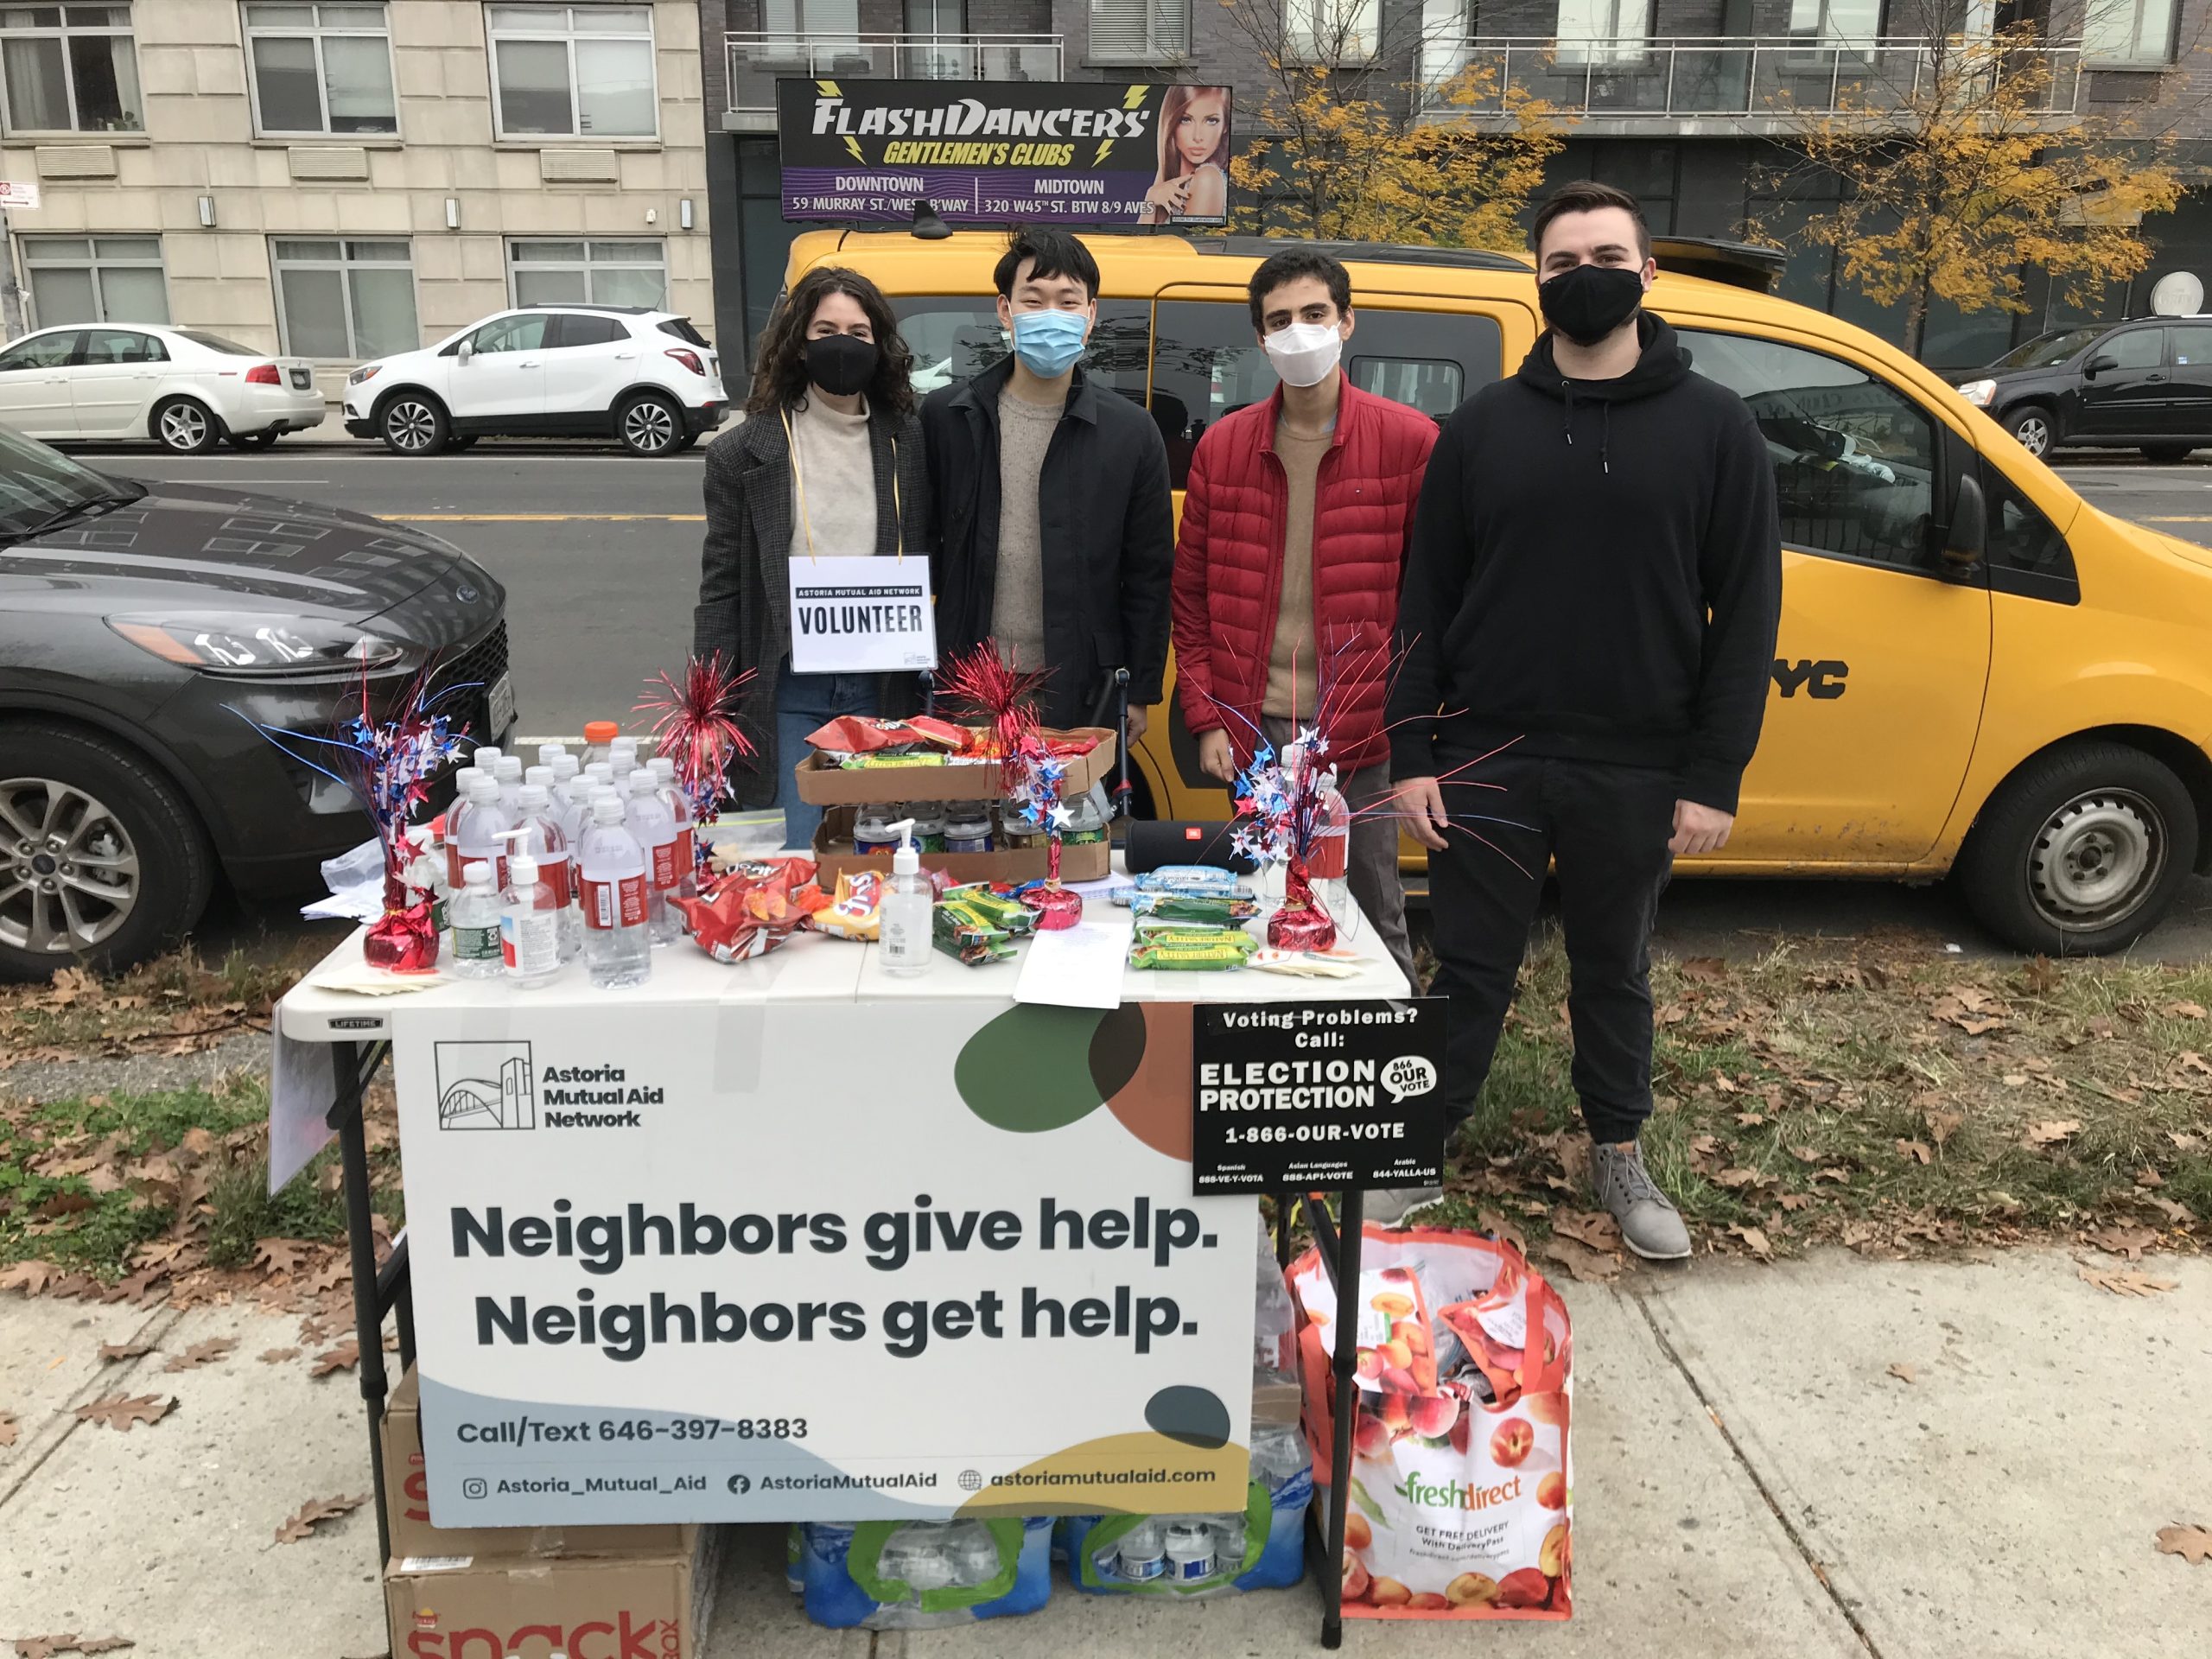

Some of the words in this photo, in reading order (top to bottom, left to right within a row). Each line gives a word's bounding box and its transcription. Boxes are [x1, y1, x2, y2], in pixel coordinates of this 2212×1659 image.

[883, 141, 1007, 165] GENTLEMEN'S
[1009, 143, 1076, 166] CLUBS
[836, 176, 925, 192] DOWNTOWN
[1034, 179, 1104, 194] MIDTOWN
[791, 197, 809, 210] 59
[812, 198, 866, 210] MURRAY
[869, 199, 918, 211] ST./WES
[931, 199, 969, 212] B'WAY
[984, 200, 1009, 213] 320
[1051, 201, 1068, 213] ST.
[1071, 201, 1100, 213] BTW
[1102, 201, 1122, 214] 8/9
[1124, 201, 1154, 214] AVES
[798, 588, 833, 597] ASTORIA
[798, 605, 923, 635] VOLUNTEER
[1770, 658, 1849, 699] YC
[1223, 1011, 1294, 1029] Voting
[1302, 1007, 1418, 1026] Problems?
[1294, 1033, 1344, 1048] Call:
[543, 1064, 626, 1083] Astoria
[1200, 1059, 1376, 1086] ELECTION
[1393, 1059, 1413, 1071] 866
[1389, 1067, 1427, 1084] OUR
[1400, 1080, 1430, 1093] VOTE
[543, 1088, 624, 1106] Mutual
[626, 1086, 664, 1105] Aid
[1200, 1085, 1375, 1112] PROTECTION
[544, 1110, 642, 1128] Network
[1225, 1122, 1405, 1143] 1-866-OUR-VOTE
[1310, 1161, 1348, 1170] Languages
[1372, 1167, 1436, 1179] 844-YALLA-US
[1198, 1174, 1264, 1184] 888-VE-Y-VOTA
[1282, 1171, 1353, 1181] 888-API-VOTE
[450, 1198, 848, 1275] Neighbors
[863, 1194, 1023, 1271] give
[1039, 1197, 1218, 1268] help.
[475, 1287, 868, 1363] Neighbors
[882, 1290, 1004, 1359] get
[1020, 1286, 1198, 1355] help.
[456, 1416, 591, 1447] Call/Text
[598, 1418, 809, 1441] 646-397-8383
[497, 1474, 707, 1496] Astoria_Mutual_Aid
[760, 1472, 938, 1491] AstoriaMutualAid
[990, 1468, 1216, 1488] astoriamutualaid.com
[1405, 1471, 1522, 1511] freshdirect
[1415, 1525, 1437, 1537] GET
[1439, 1529, 1464, 1541] FREE
[1466, 1521, 1510, 1541] DELIVERY
[1421, 1536, 1446, 1549] With
